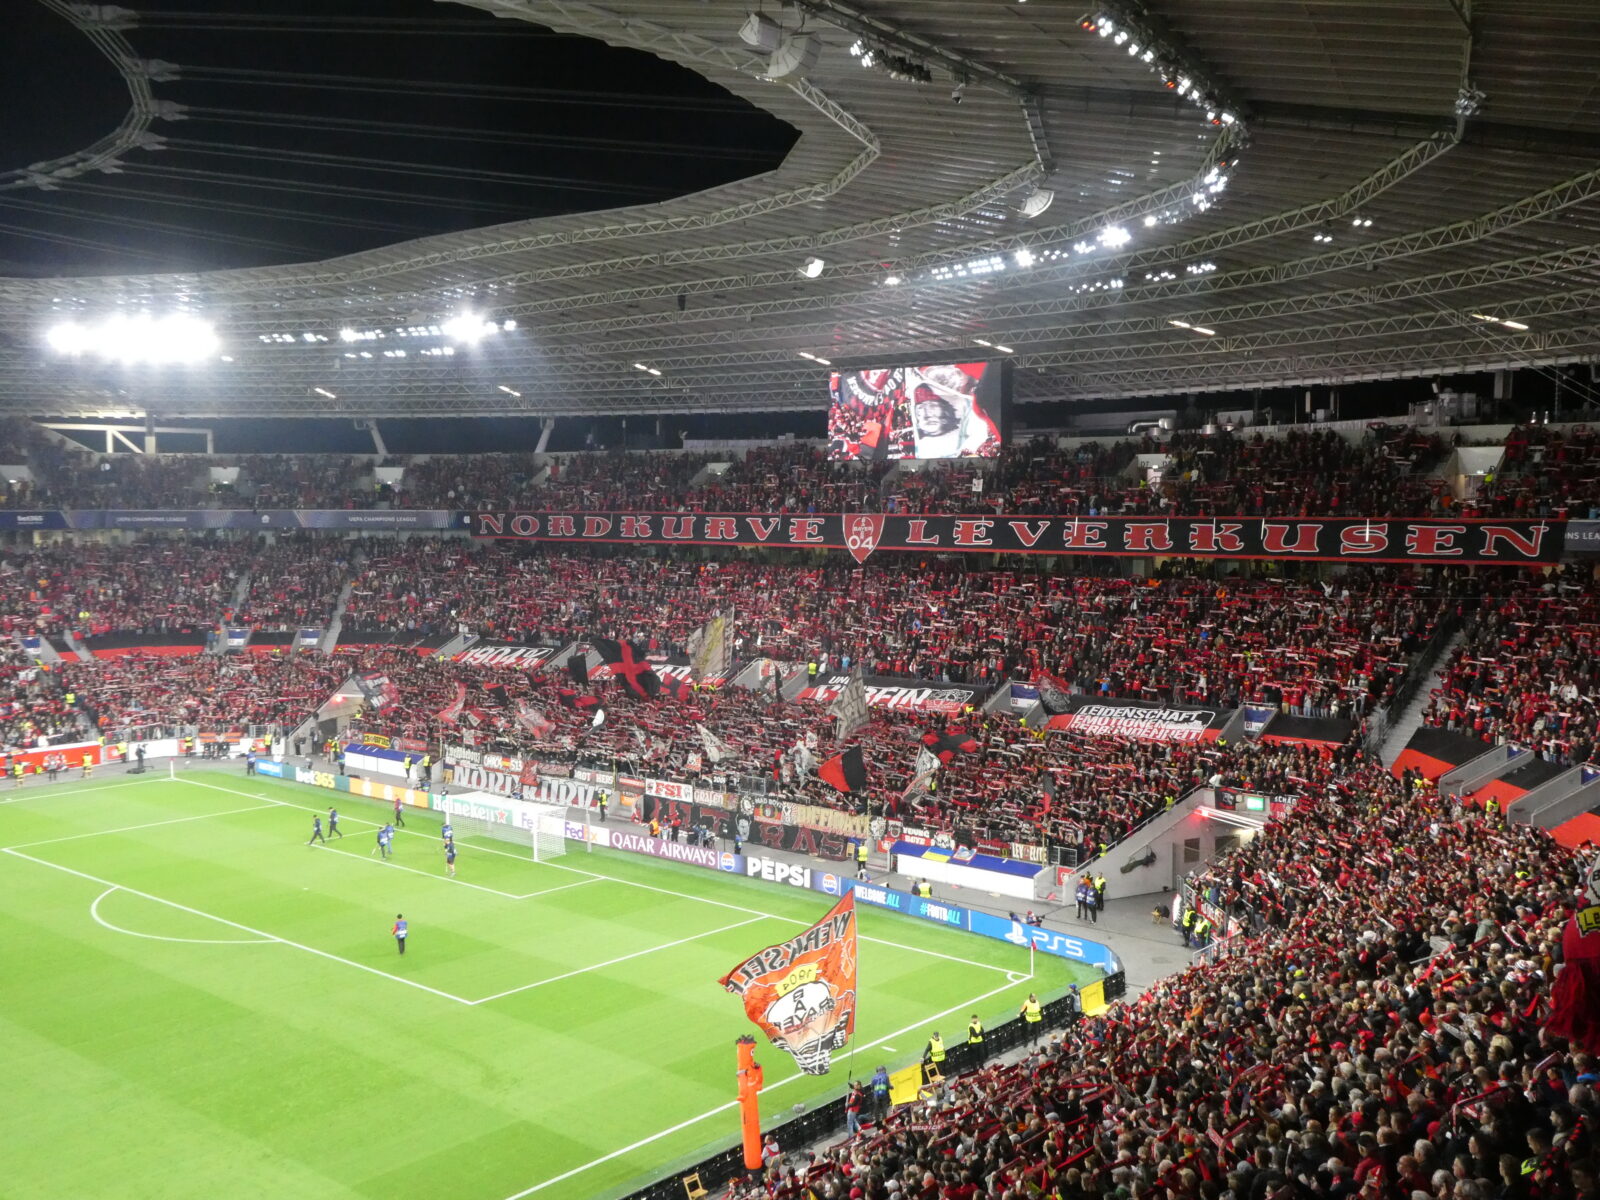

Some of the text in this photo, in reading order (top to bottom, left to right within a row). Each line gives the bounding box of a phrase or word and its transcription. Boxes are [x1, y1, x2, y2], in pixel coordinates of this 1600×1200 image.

[479, 513, 825, 543] NORDKURVE
[906, 520, 1550, 557] LEVERKUSEN
[849, 535, 873, 550] 04
[1074, 714, 1171, 730] EMOTIONEN
[1080, 706, 1203, 722] LEIDENSCHAFT
[296, 766, 336, 789] bet365
[564, 820, 598, 843] FedEx
[611, 831, 716, 866] QATAR AIRWAYS
[747, 857, 811, 889] PEPSI
[919, 902, 961, 925] #FOOTBALL
[1031, 930, 1084, 957] PS5
